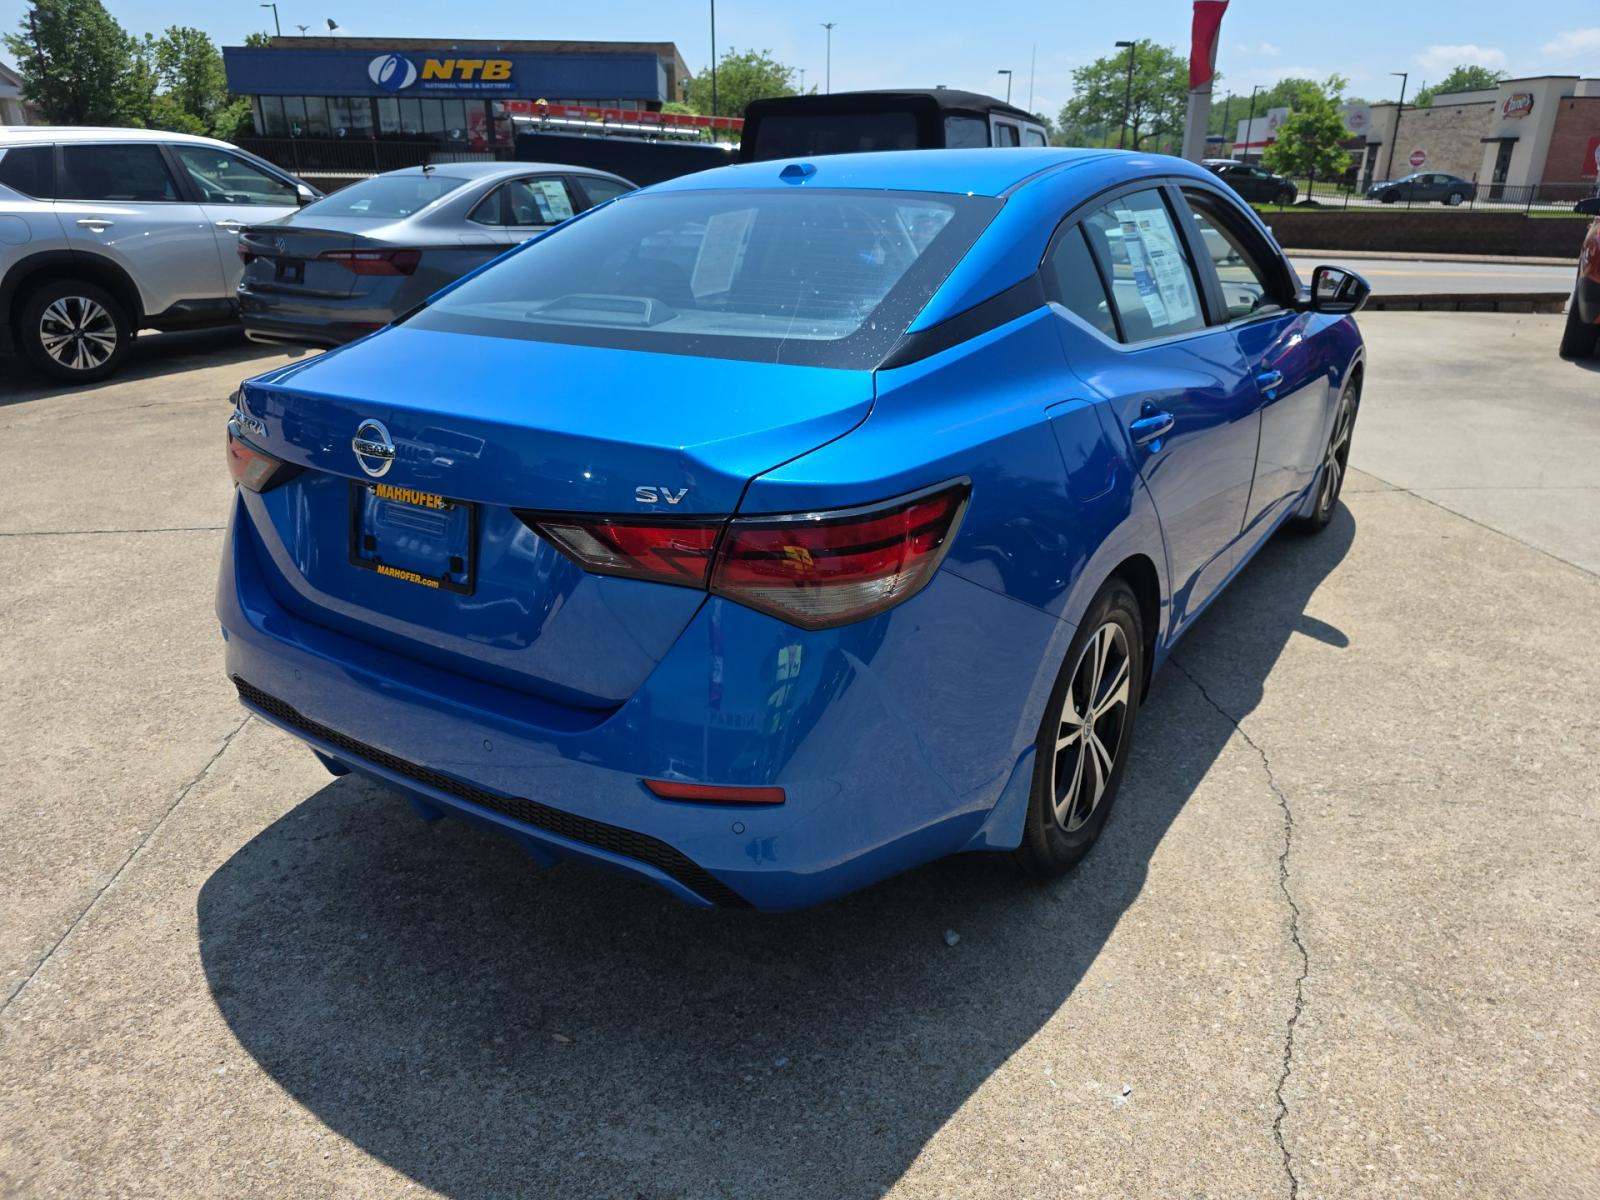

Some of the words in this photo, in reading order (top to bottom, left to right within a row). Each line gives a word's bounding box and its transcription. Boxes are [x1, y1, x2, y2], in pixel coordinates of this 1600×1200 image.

[422, 59, 513, 80] NTB
[354, 440, 392, 457] NISSAN
[376, 483, 443, 509] MARHOFER
[636, 486, 688, 504] SV
[377, 564, 440, 589] MARHOFER.com
